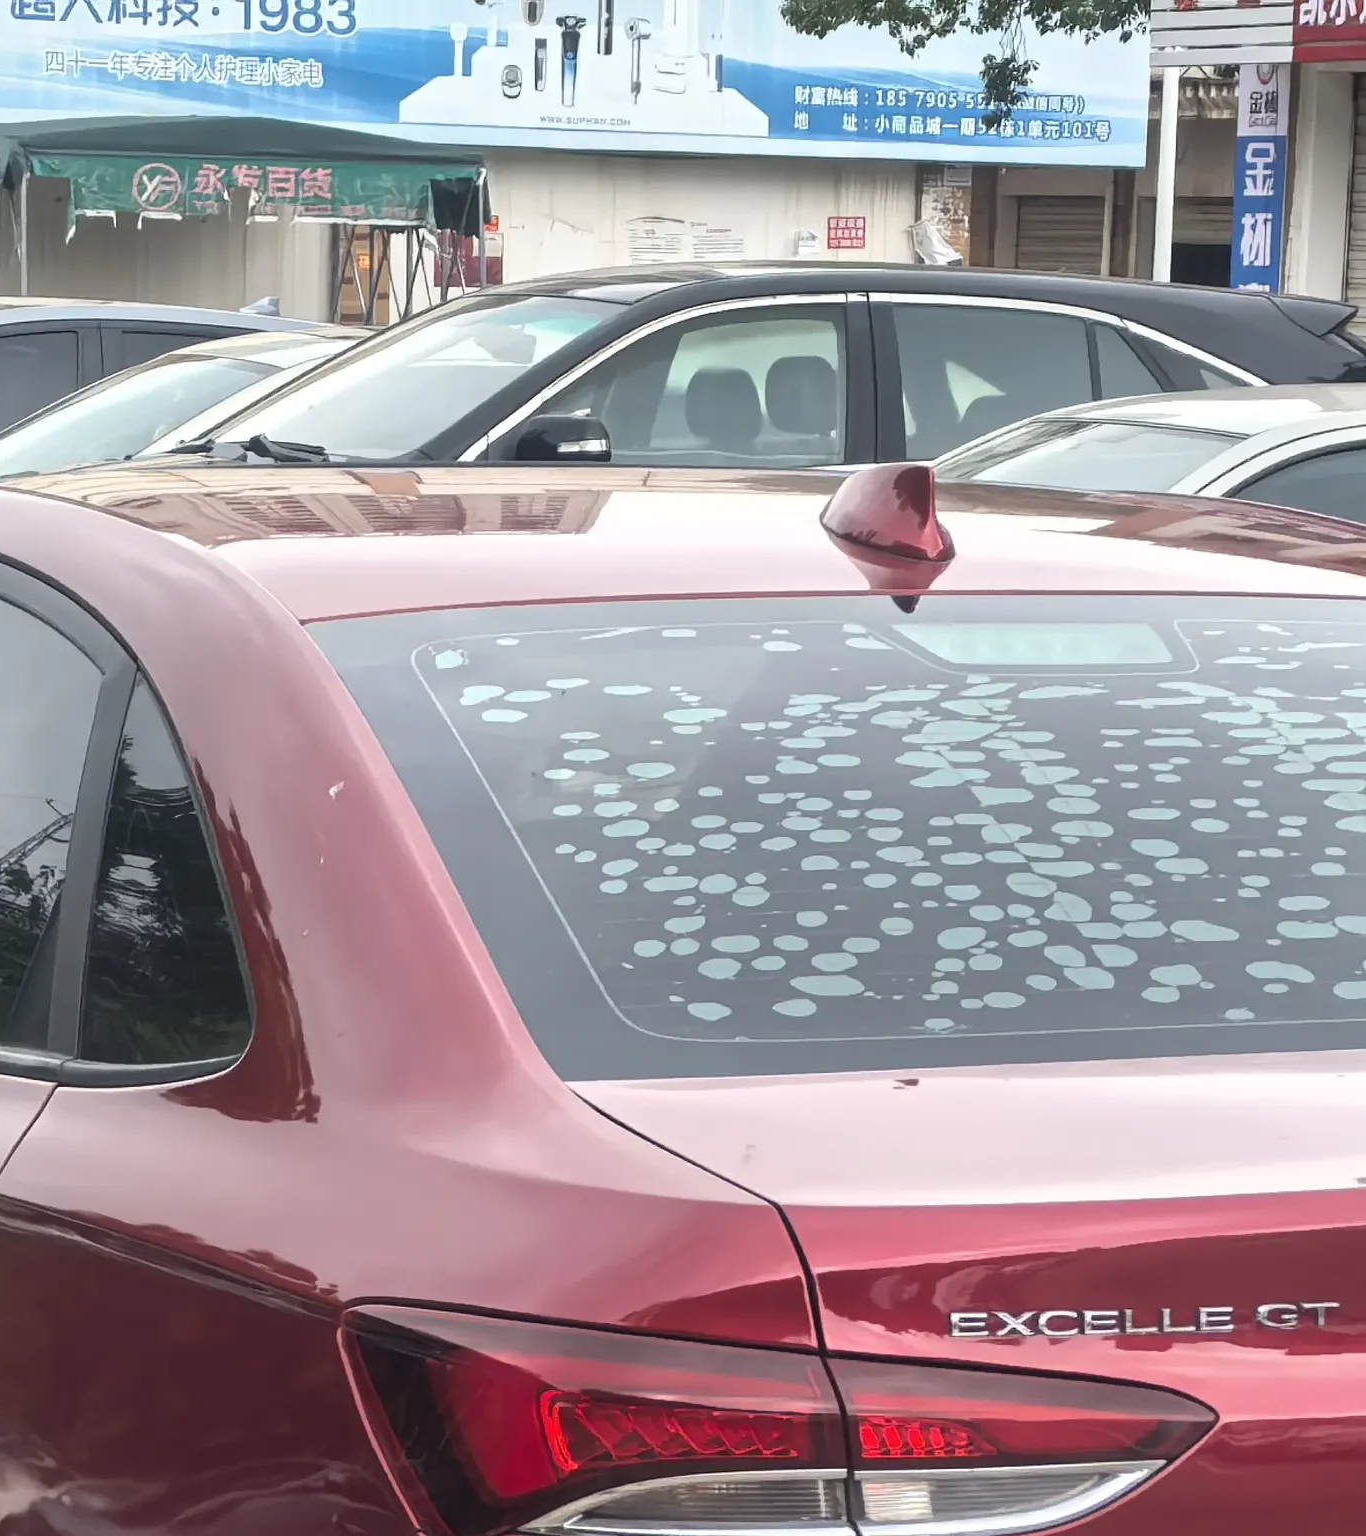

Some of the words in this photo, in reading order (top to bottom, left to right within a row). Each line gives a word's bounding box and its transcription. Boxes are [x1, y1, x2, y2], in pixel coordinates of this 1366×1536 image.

[43, 49, 325, 88] 四十一年专注个人护理小家电
[194, 163, 334, 200] 永发百货
[1237, 141, 1277, 292] 金杯
[949, 1306, 1234, 1338] EXCELLE
[1256, 1302, 1341, 1329] GT
